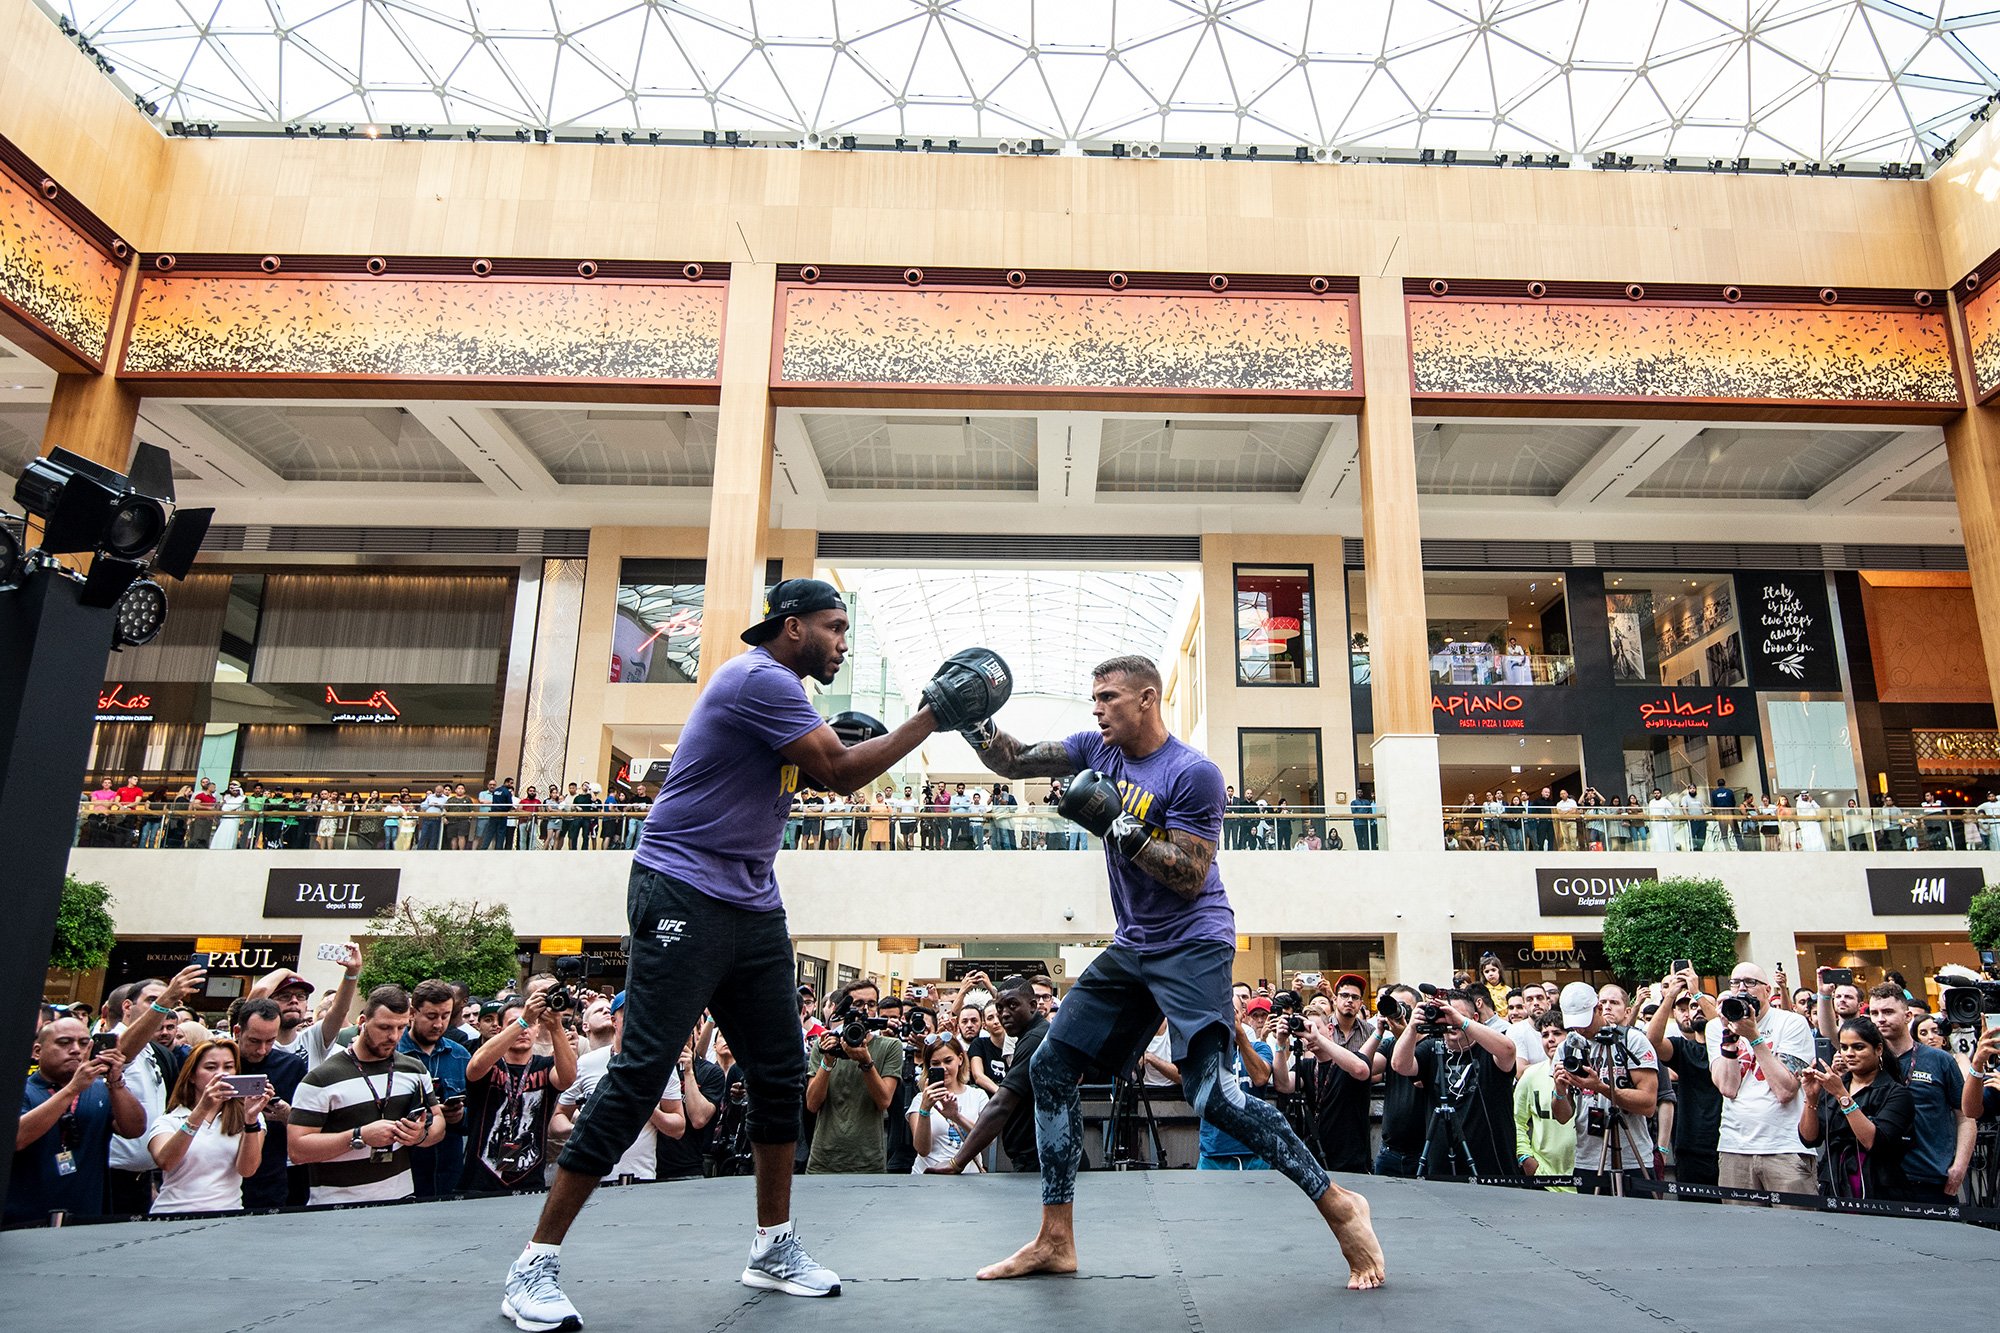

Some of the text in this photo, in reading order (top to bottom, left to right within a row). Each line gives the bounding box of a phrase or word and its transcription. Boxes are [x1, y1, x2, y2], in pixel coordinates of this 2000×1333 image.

[1762, 583, 1795, 603] Italy
[781, 599, 799, 609] UFC
[1767, 598, 1804, 617] is just
[1761, 612, 1813, 628] two steps
[1762, 639, 1795, 654] Come
[980, 657, 1007, 686] LEONE
[1459, 719, 1477, 728] PASTA
[1481, 719, 1498, 728] PIZZA
[1502, 719, 1525, 728] LOUNGE
[296, 883, 366, 902] PAUL
[1911, 877, 1946, 905] H&M
[326, 902, 363, 910] depuis 1889
[1578, 897, 1606, 906] Belgium
[657, 919, 686, 932] UFC
[207, 948, 278, 968] PAUL
[1517, 948, 1587, 961] GODIVA
[1053, 964, 1063, 975] G
